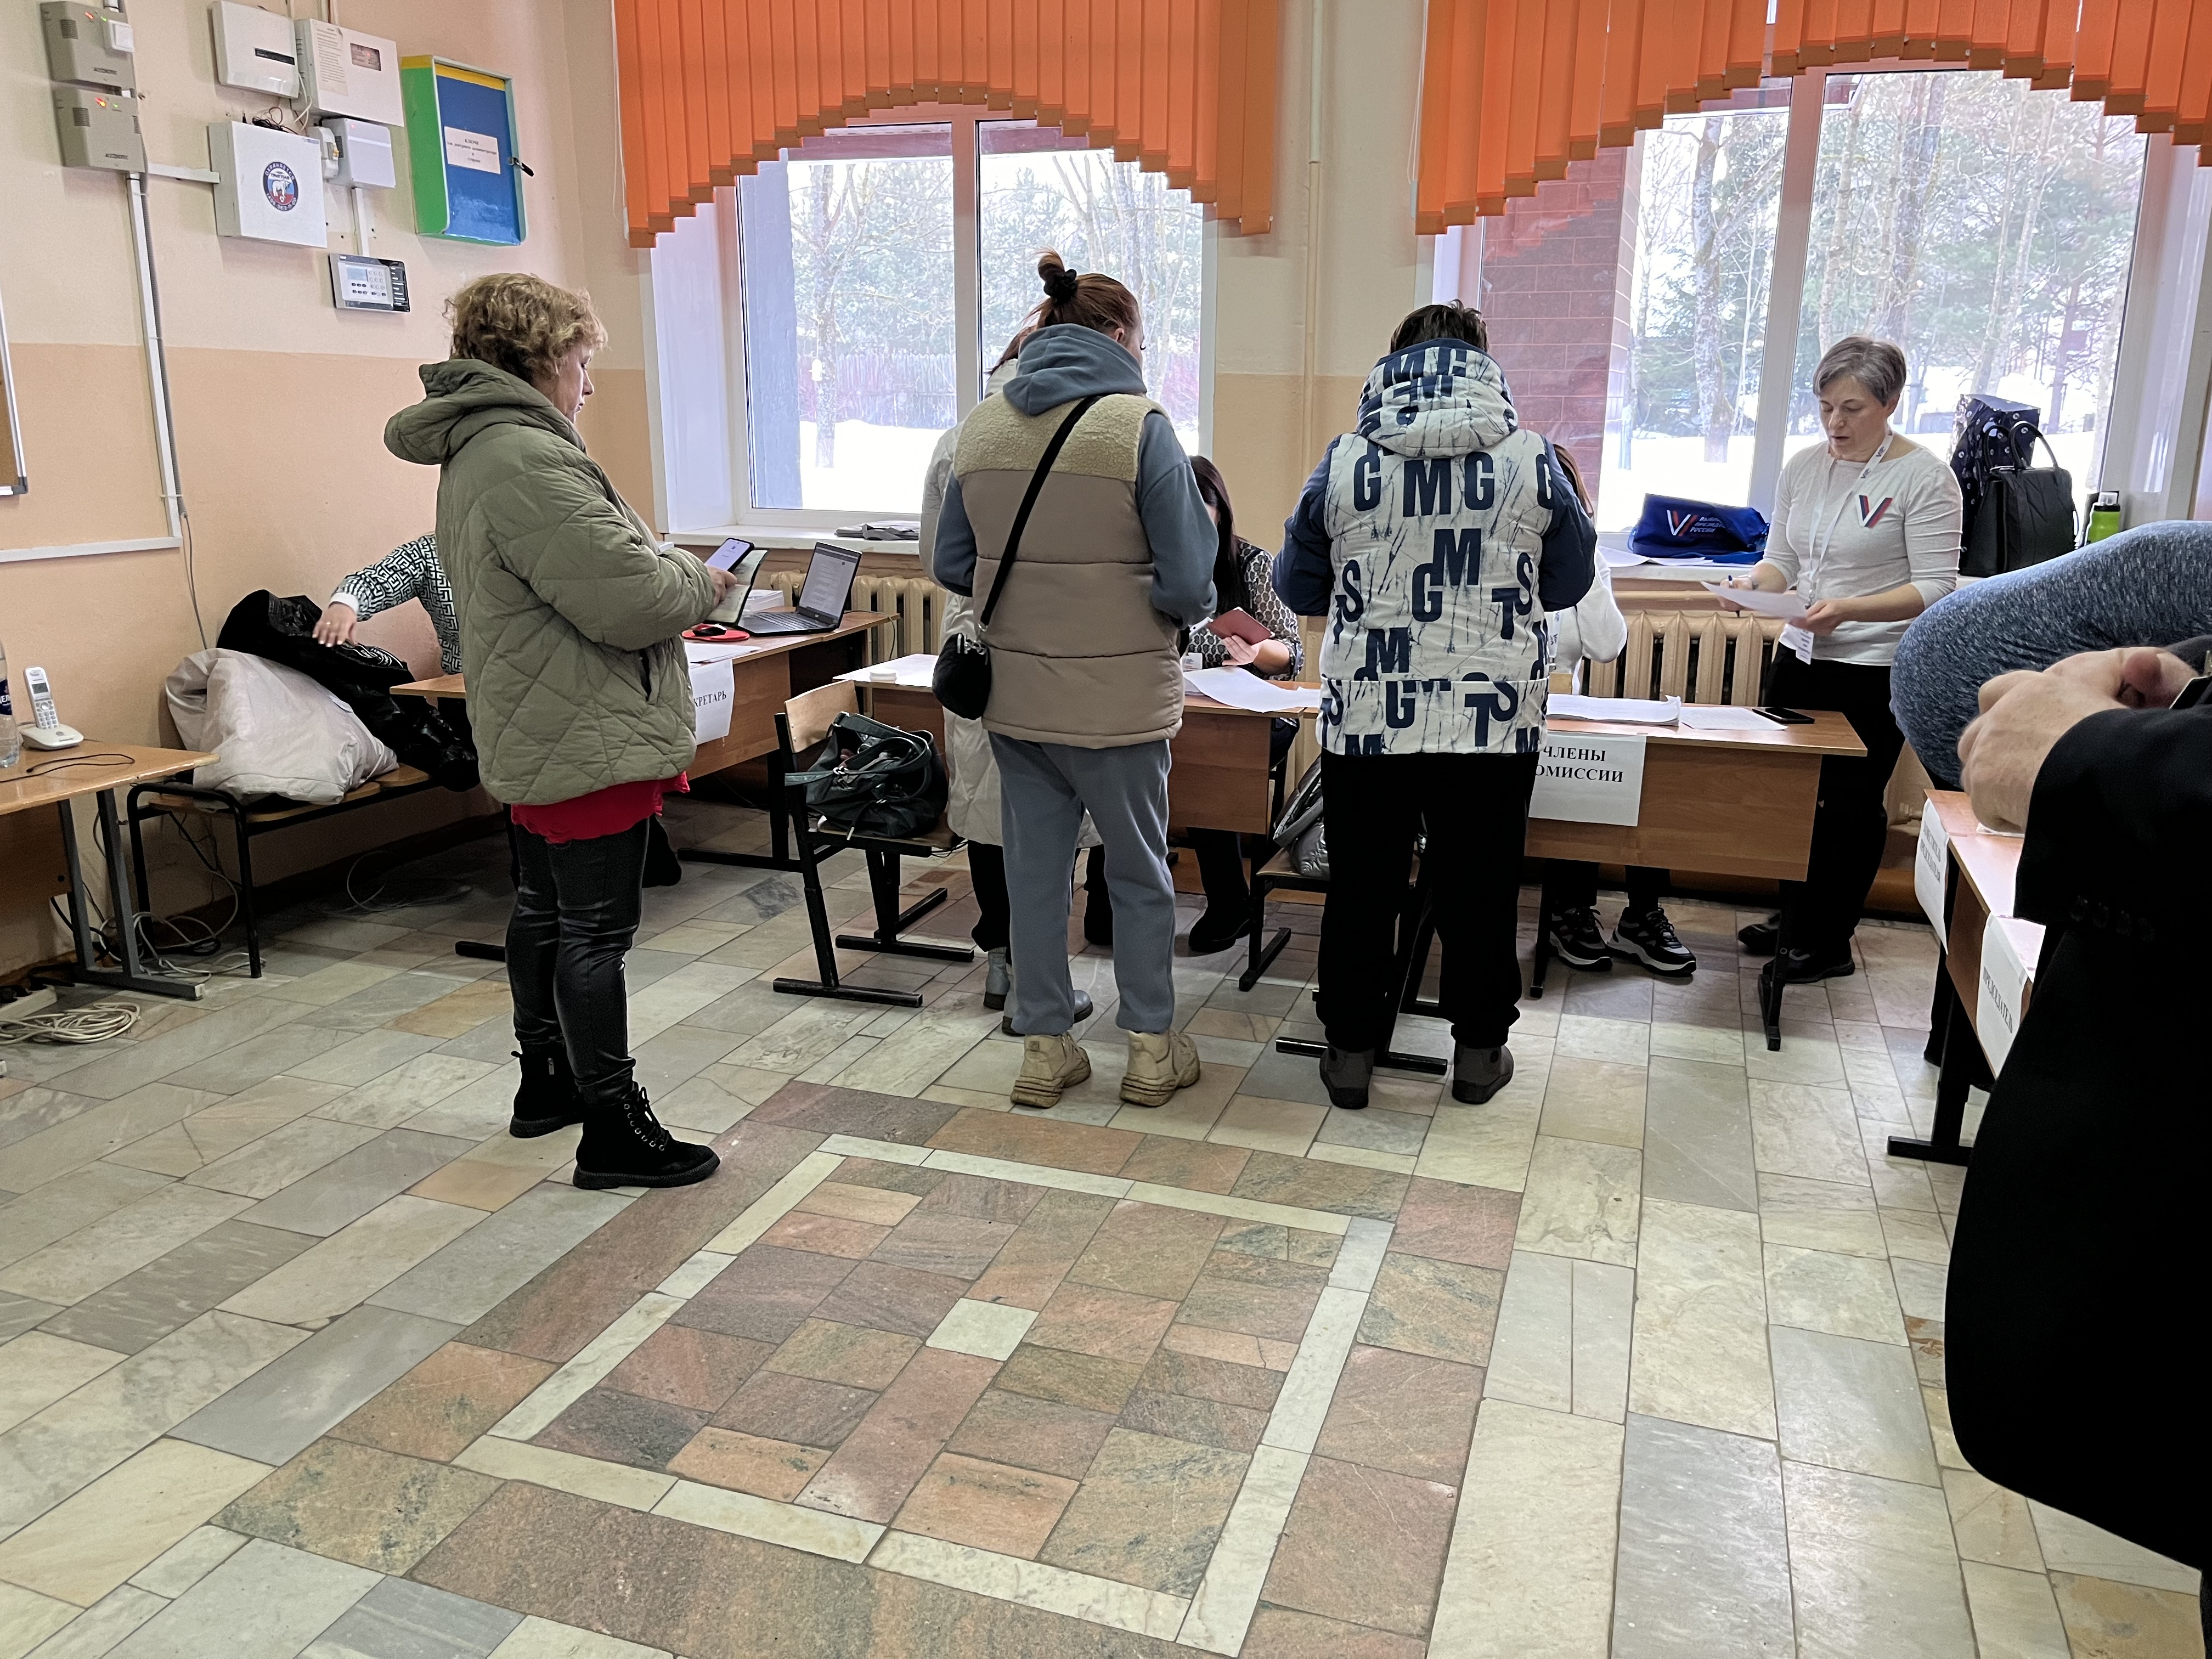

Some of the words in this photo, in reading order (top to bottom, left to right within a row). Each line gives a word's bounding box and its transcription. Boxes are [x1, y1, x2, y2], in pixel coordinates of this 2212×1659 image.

[1403, 458, 1451, 517] M
[1464, 452, 1495, 510] G
[1430, 528, 1481, 586] M
[1342, 560, 1364, 623] S
[1412, 563, 1443, 622] G
[1492, 588, 1520, 640] T
[1365, 627, 1409, 673] M
[693, 691, 726, 707] КРЕТАРЬ
[1465, 693, 1498, 747] T
[1536, 764, 1623, 782] ОМИССИИ
[1543, 746, 1606, 761] ЧЛЕНЫ
